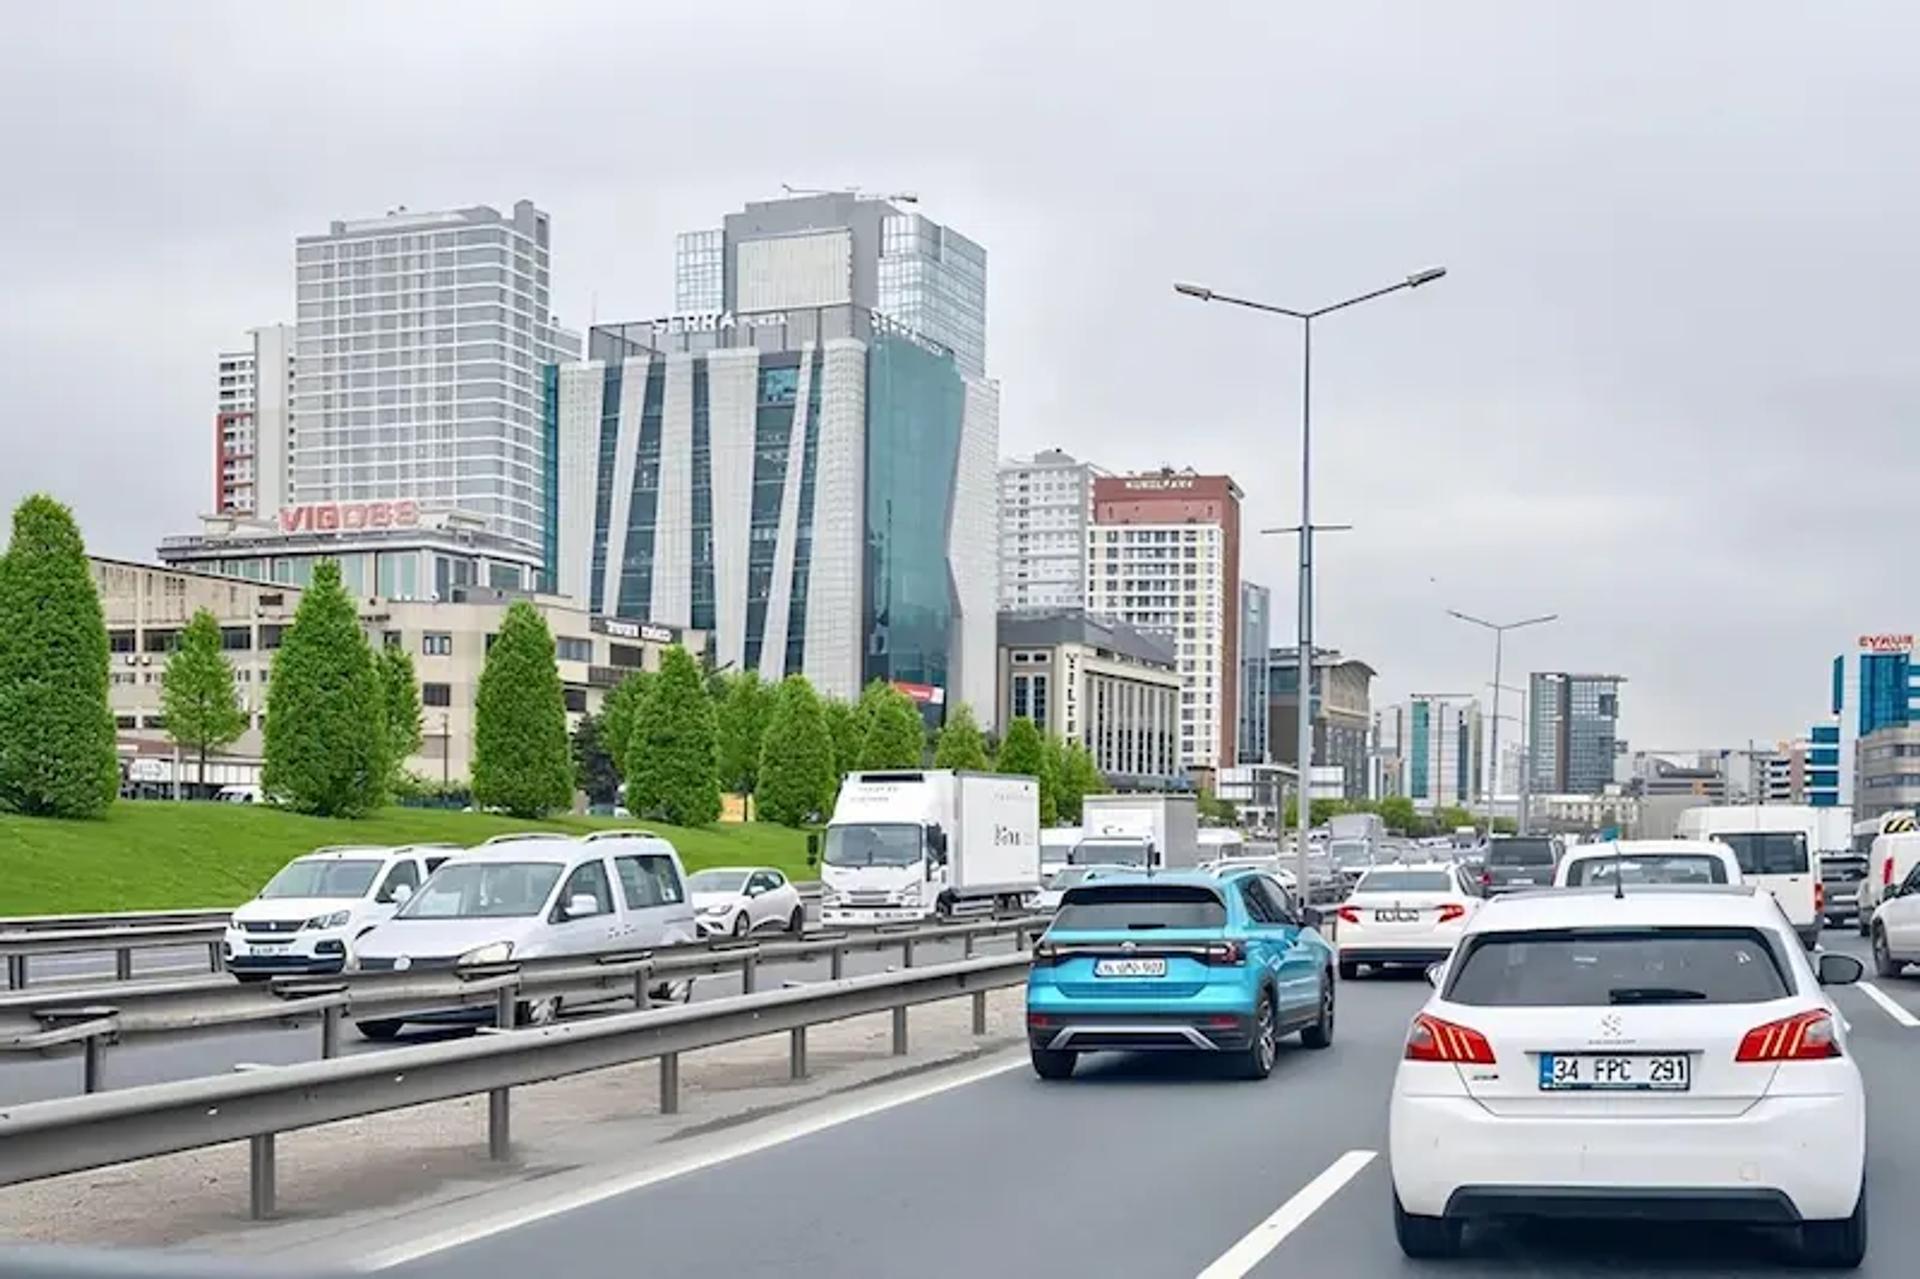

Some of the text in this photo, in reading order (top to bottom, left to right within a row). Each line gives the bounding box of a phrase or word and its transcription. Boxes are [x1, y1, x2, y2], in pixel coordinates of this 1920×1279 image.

[1554, 1058, 1685, 1082] 34 FPC 291
